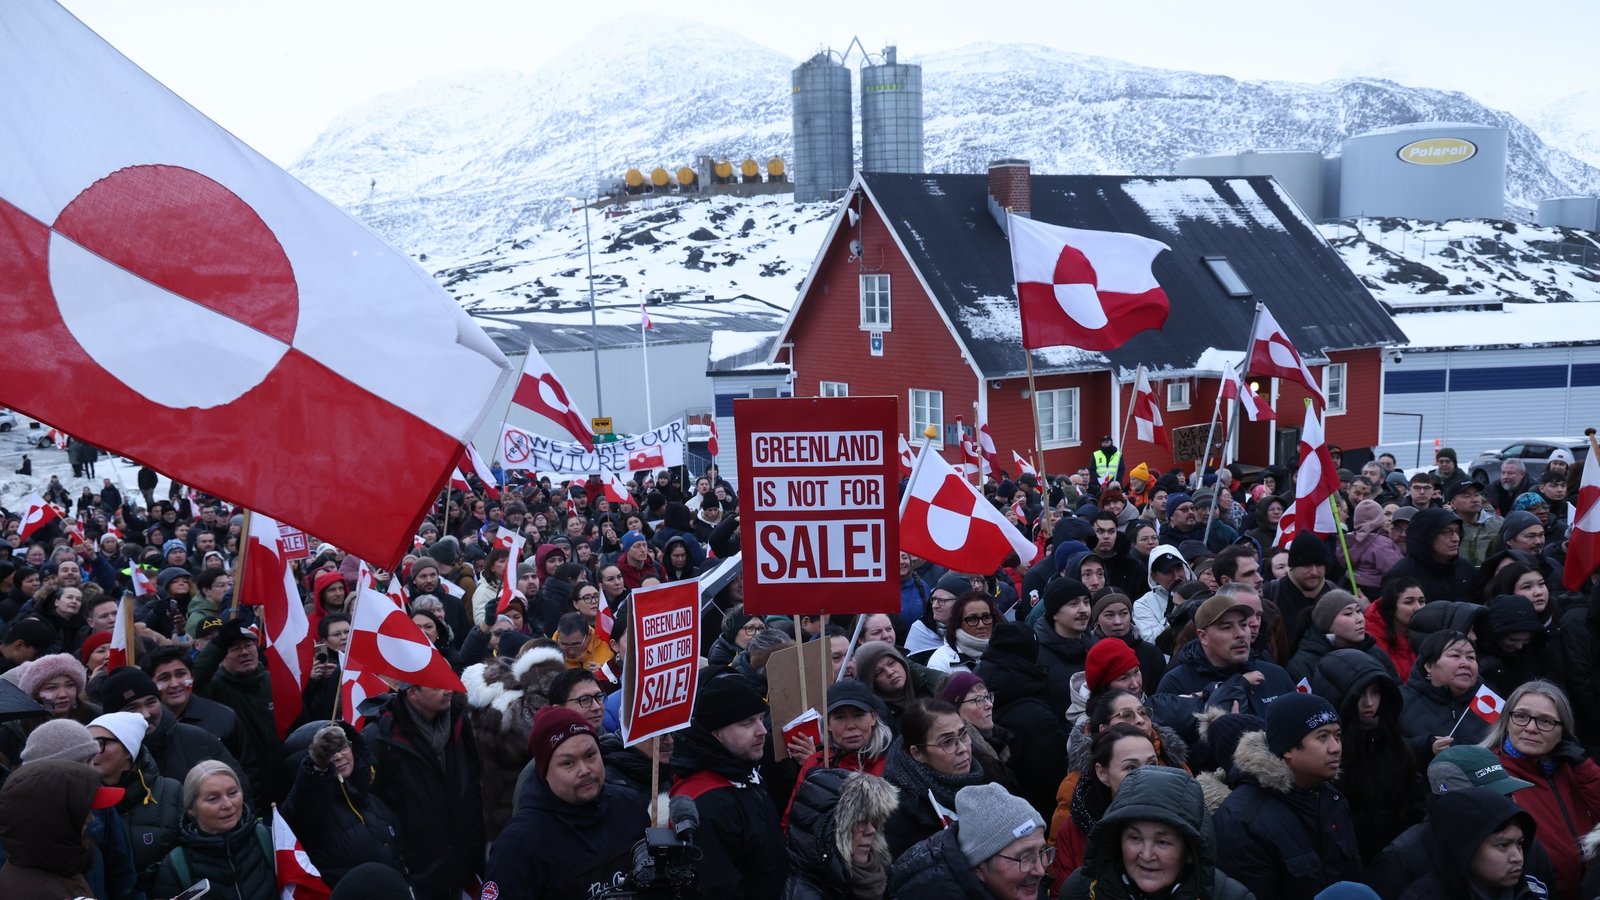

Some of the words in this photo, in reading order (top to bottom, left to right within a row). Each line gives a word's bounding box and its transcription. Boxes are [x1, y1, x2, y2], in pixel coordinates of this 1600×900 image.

[527, 434, 562, 453] WE
[642, 422, 683, 446] OUR
[755, 435, 879, 463] GREENLAND
[530, 448, 626, 471] FUTURE
[757, 481, 776, 507] IS
[788, 480, 828, 507] NOT
[841, 479, 880, 506] FOR
[282, 536, 303, 550] ALE!
[760, 523, 882, 580] SALE!
[644, 609, 692, 637] GREENLAND
[645, 648, 654, 667] IS
[657, 642, 673, 663] NOT
[676, 638, 691, 658] FOR
[641, 666, 690, 714] SALE!
